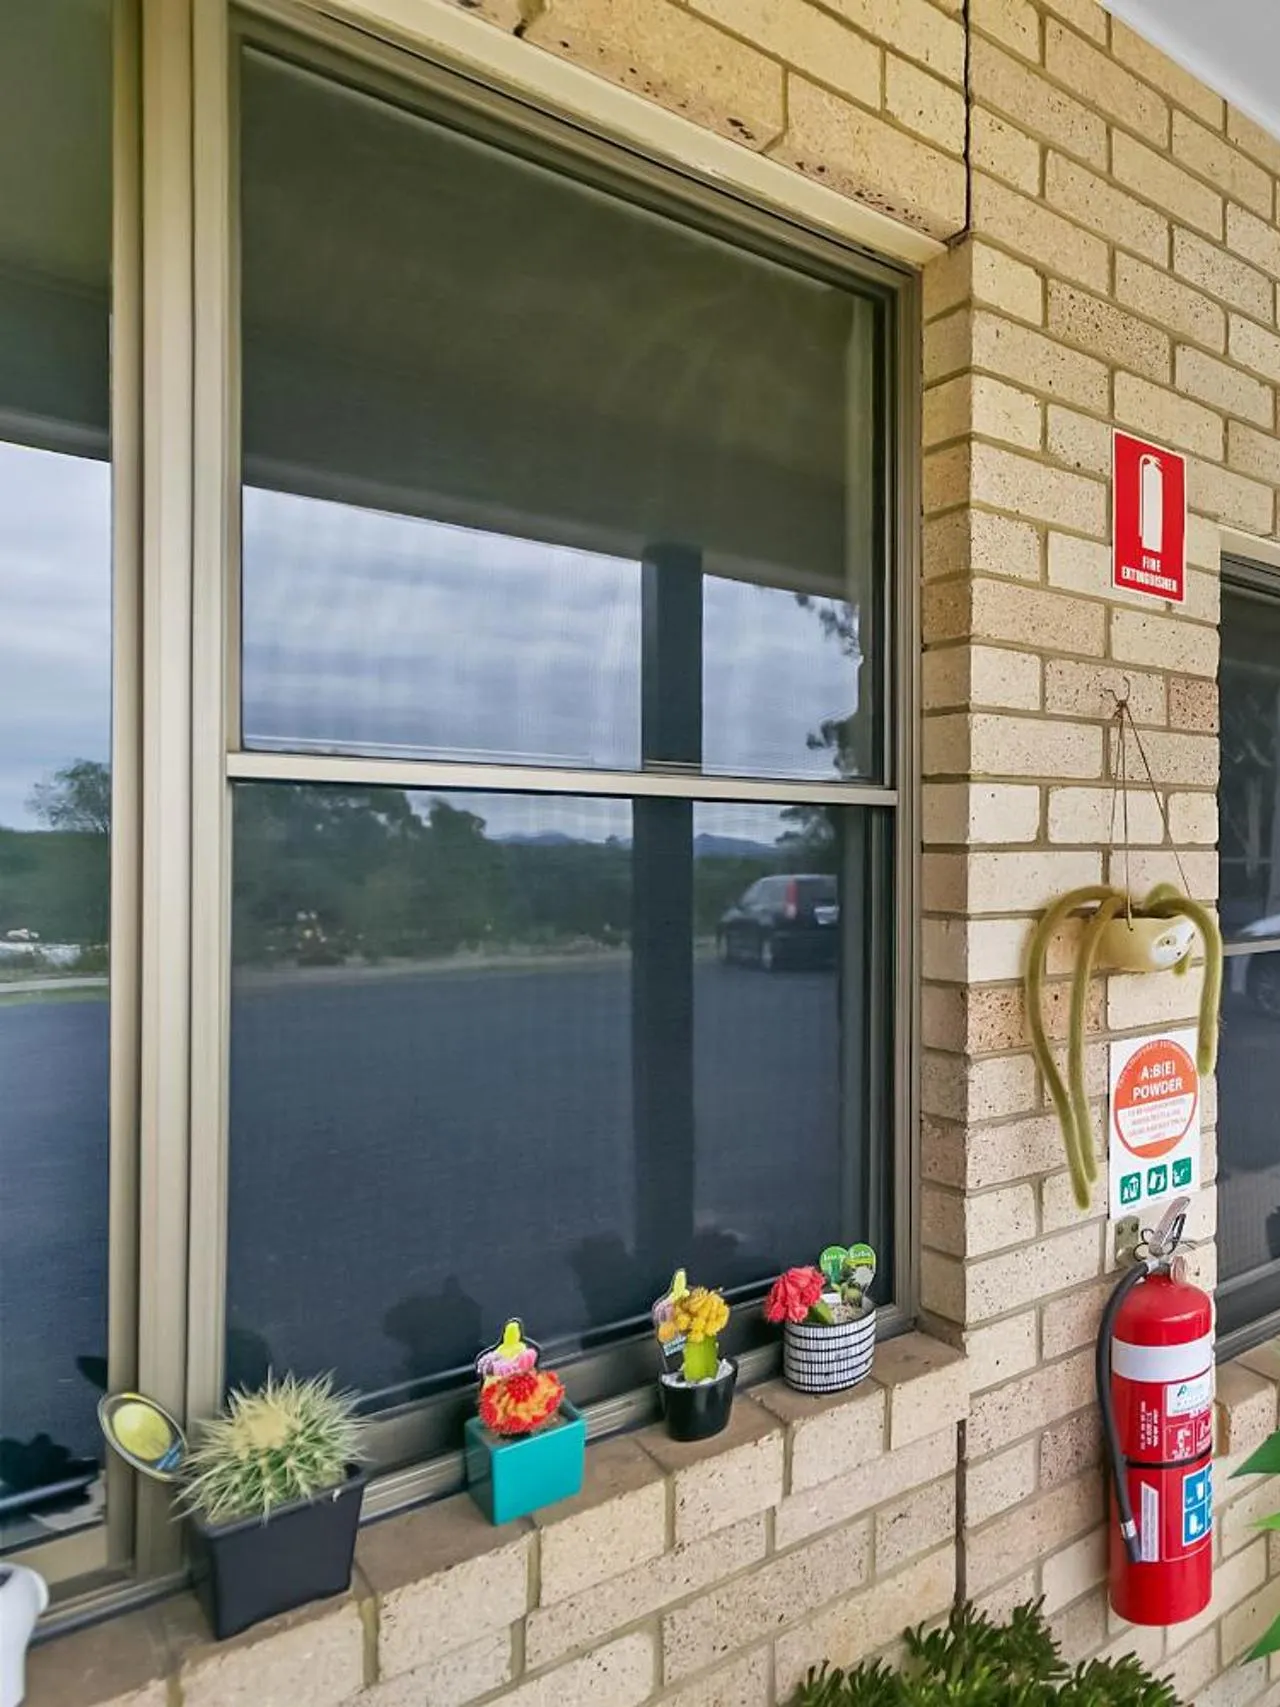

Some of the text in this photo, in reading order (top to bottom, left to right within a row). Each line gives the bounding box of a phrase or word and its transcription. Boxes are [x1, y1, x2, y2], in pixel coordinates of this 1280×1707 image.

[1143, 555, 1161, 573] FIRE
[1121, 566, 1177, 593] EXTINGUISHER
[1132, 1076, 1184, 1101] POWDER
